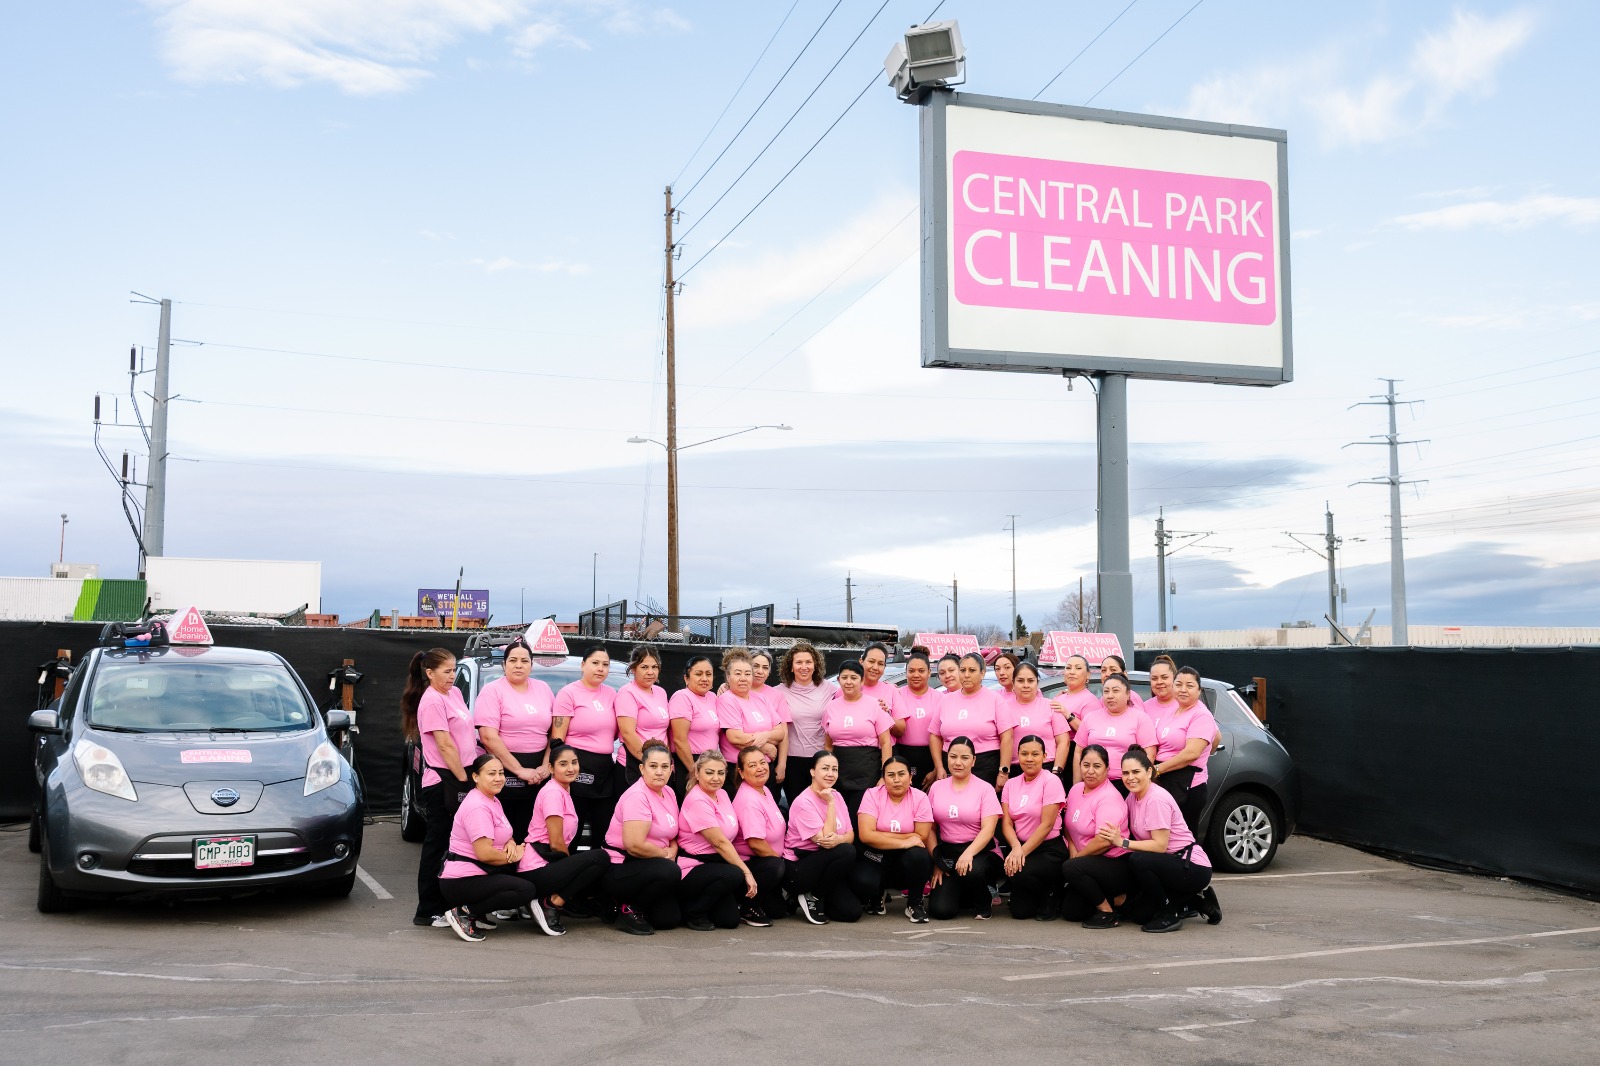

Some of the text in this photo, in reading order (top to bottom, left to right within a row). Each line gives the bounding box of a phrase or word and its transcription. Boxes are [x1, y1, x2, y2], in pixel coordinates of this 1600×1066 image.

[962, 172, 1265, 238] CENTRAL PARK
[964, 229, 1267, 305] CLEANING
[174, 632, 208, 641] Cleaning
[1056, 636, 1117, 646] CENTRAL PARK
[536, 642, 564, 650] Cleaning
[1060, 646, 1120, 658] CLEANING
